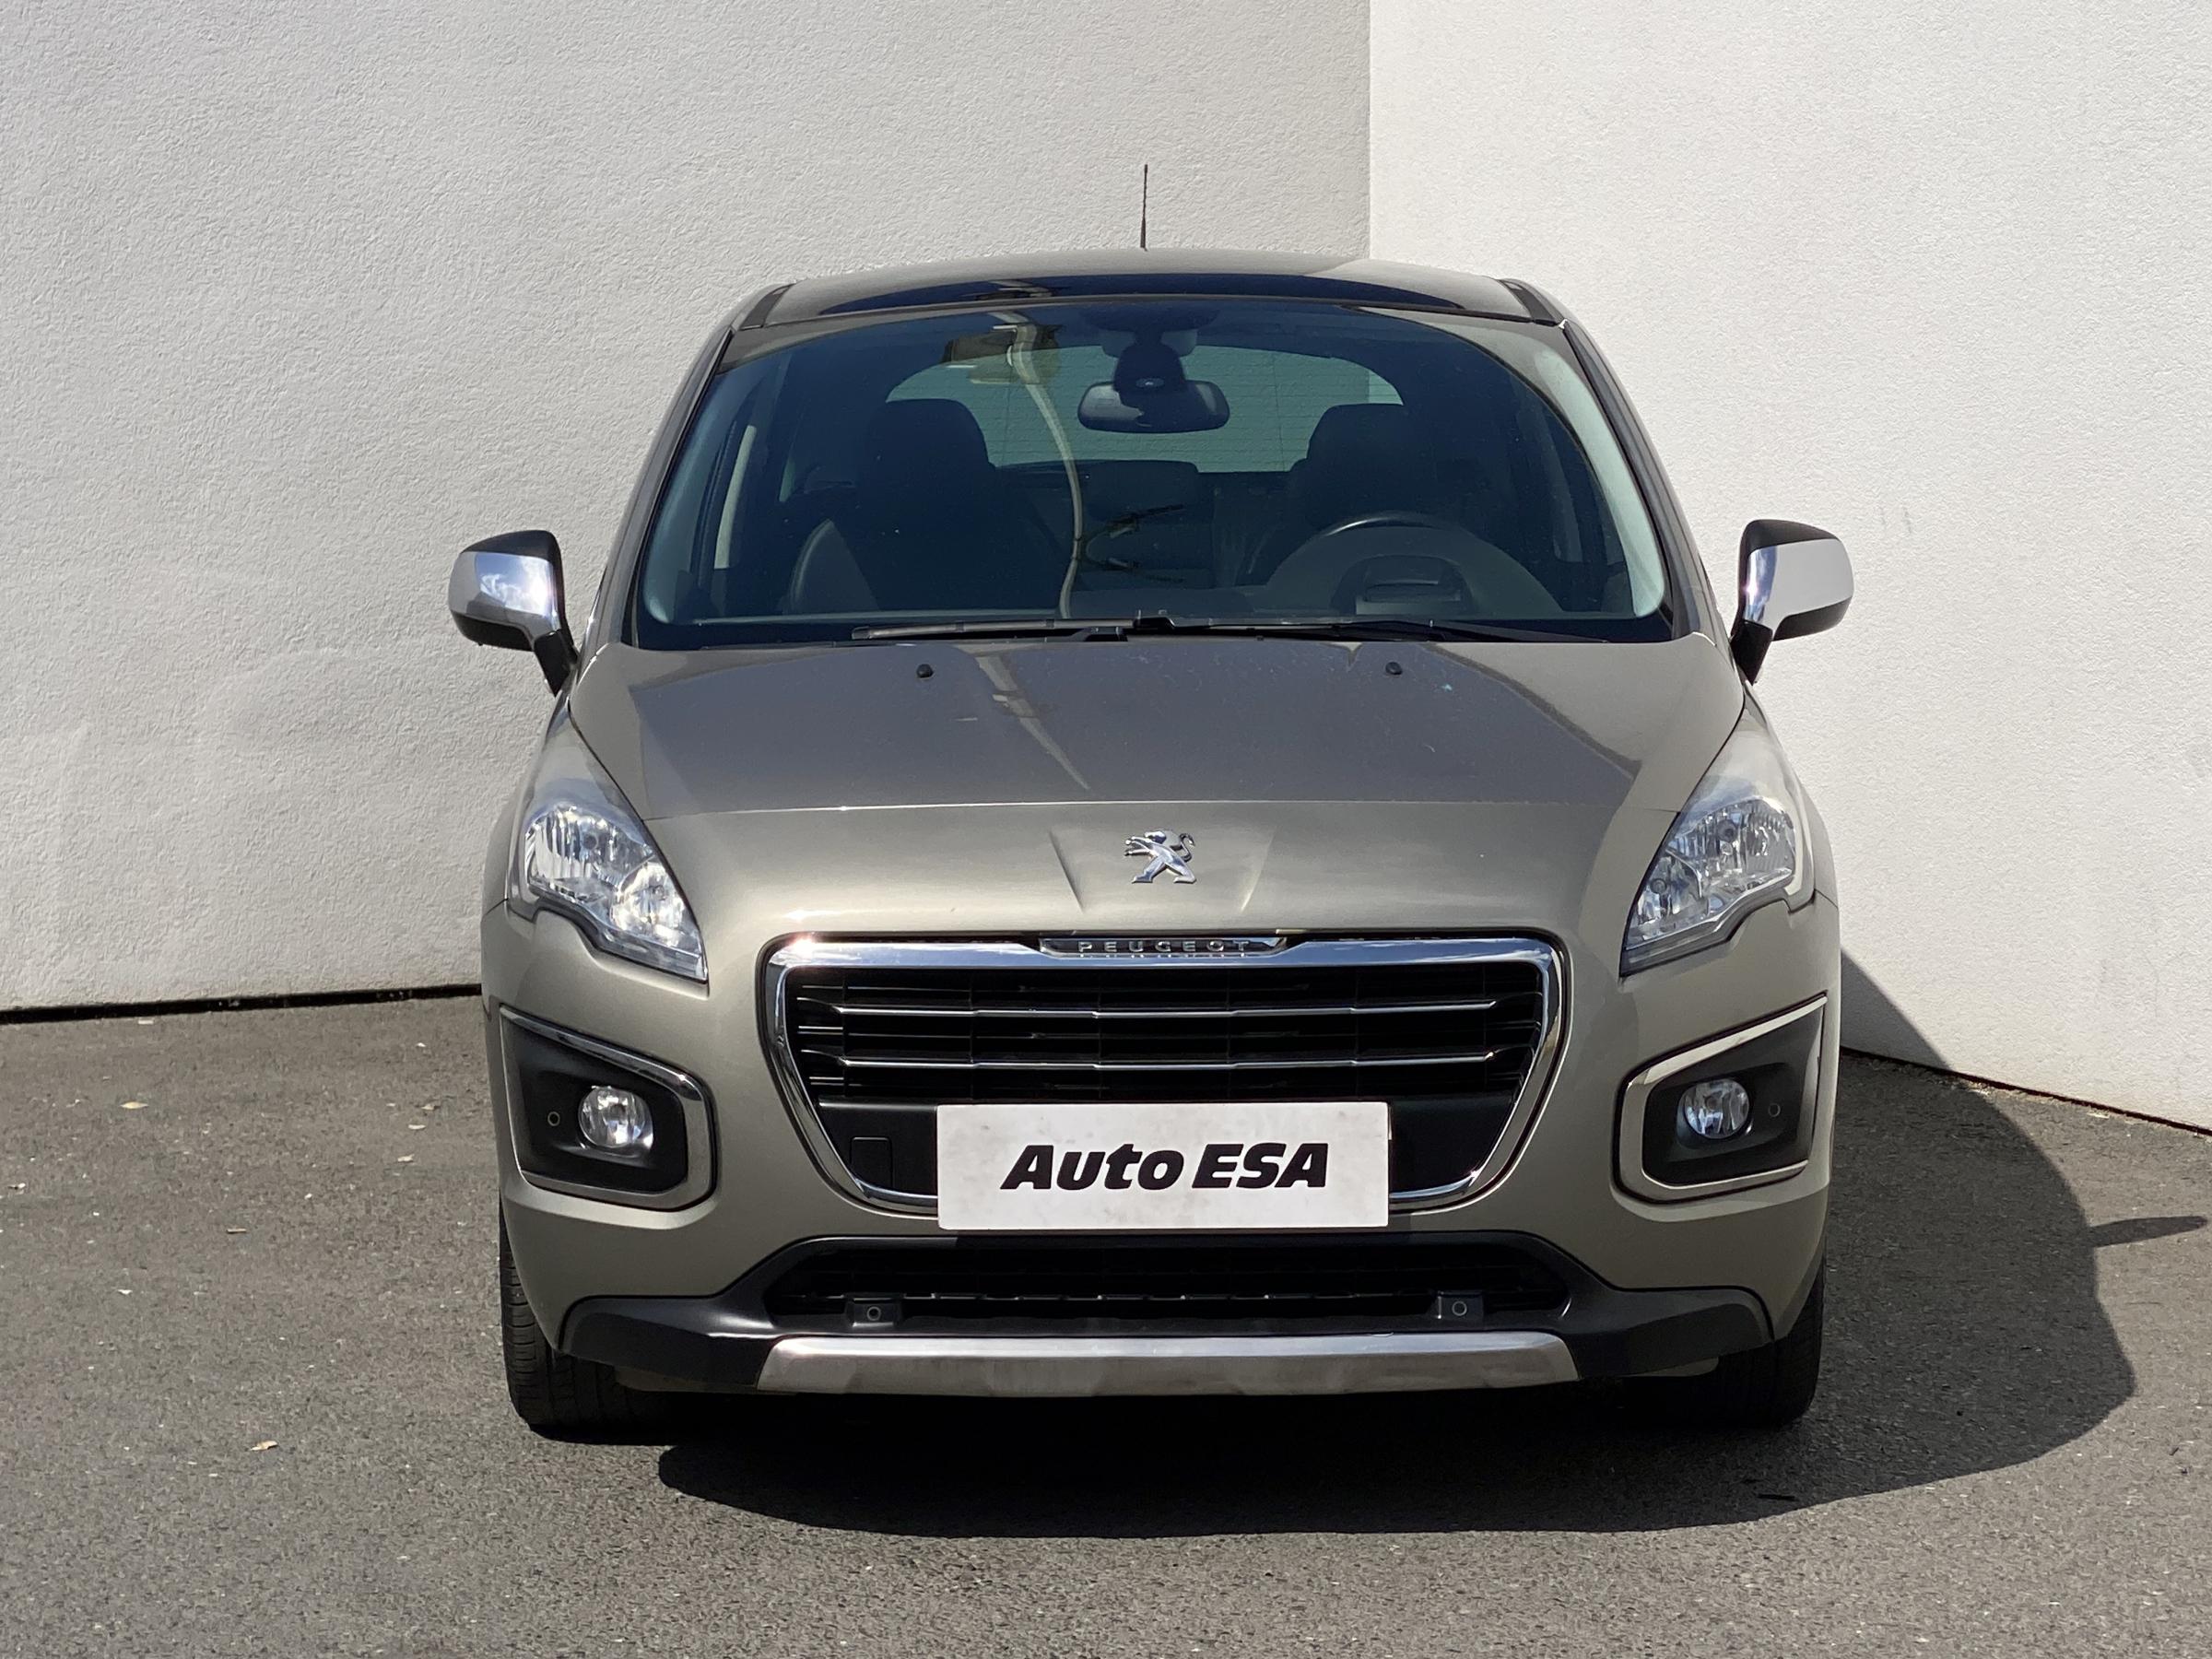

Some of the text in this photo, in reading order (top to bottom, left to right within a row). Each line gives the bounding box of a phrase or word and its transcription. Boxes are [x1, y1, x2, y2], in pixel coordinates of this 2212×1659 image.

[1077, 940, 1249, 953] PEUGEOT
[1000, 1143, 1328, 1191] Auto ESA
